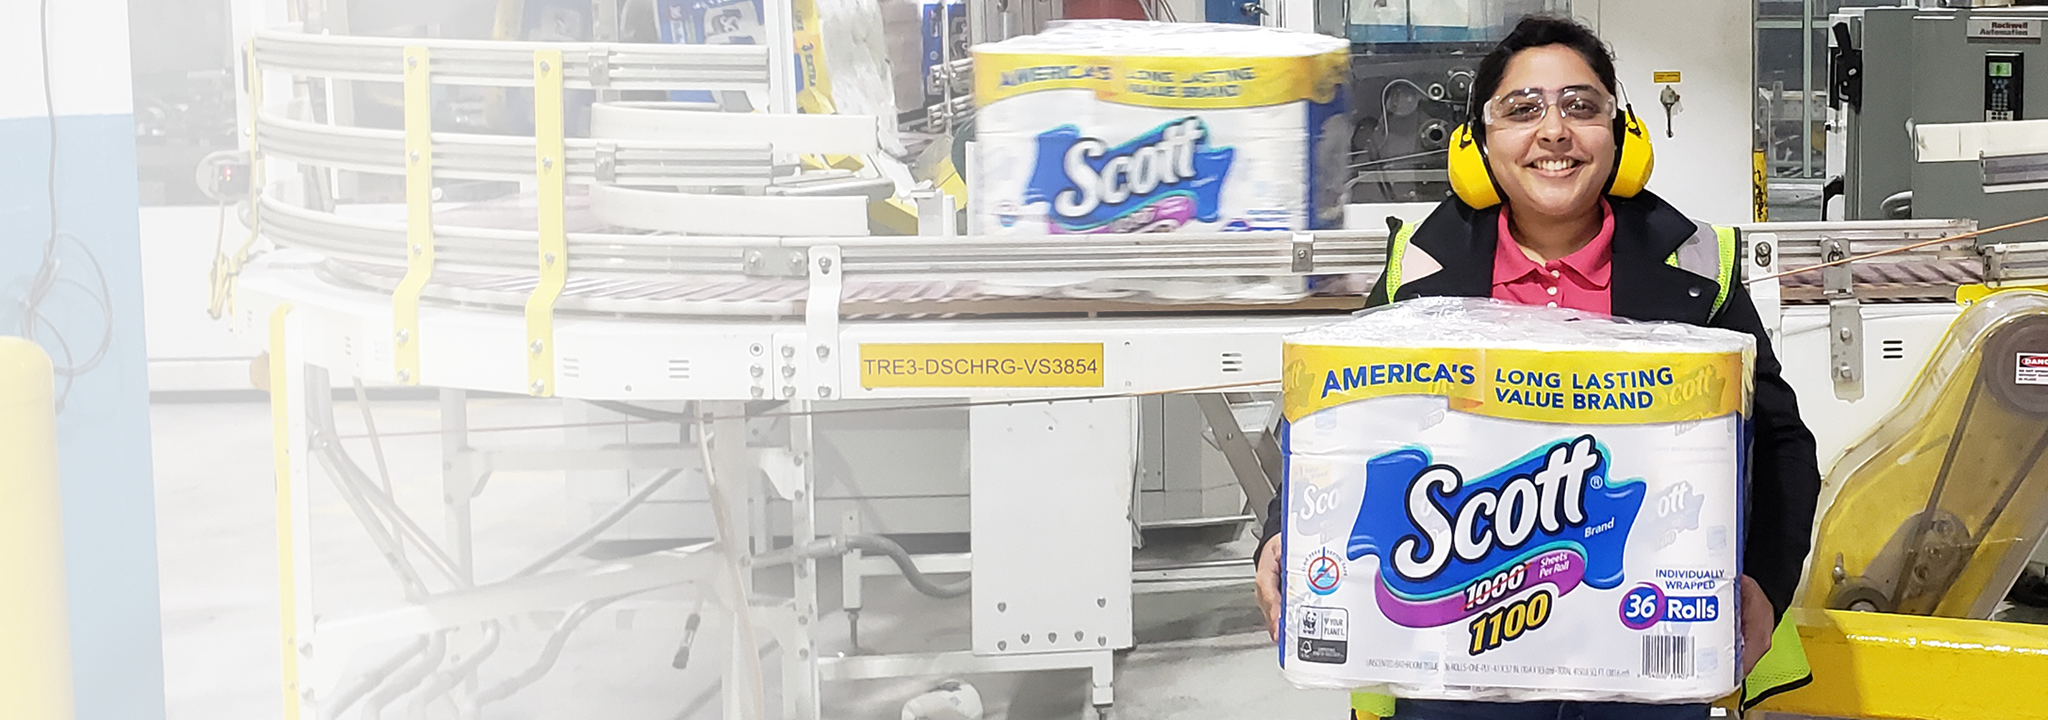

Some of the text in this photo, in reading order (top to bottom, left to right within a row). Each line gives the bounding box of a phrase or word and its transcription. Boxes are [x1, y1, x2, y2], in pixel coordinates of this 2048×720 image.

[1980, 28, 2028, 36] Automation
[1055, 116, 1206, 217] Scott
[864, 358, 1098, 375] TRE3-DSCHRG-VS3854
[1321, 362, 1476, 399] AMERICA'S
[1495, 368, 1560, 388] LONG
[1573, 367, 1674, 389] LASTING
[1495, 387, 1653, 410] VALUE BRAND
[1391, 435, 1601, 581] Scott
[1584, 516, 1615, 538] Brand
[1539, 560, 1570, 579] Per Roll
[1540, 551, 1568, 568] Sheets
[1655, 569, 1725, 579] INDIVIDUALLY
[1665, 580, 1716, 590] WRAPPED
[1466, 564, 1527, 609] 1000
[1625, 593, 1717, 620] 36 Rolls
[1470, 591, 1551, 655] 1100
